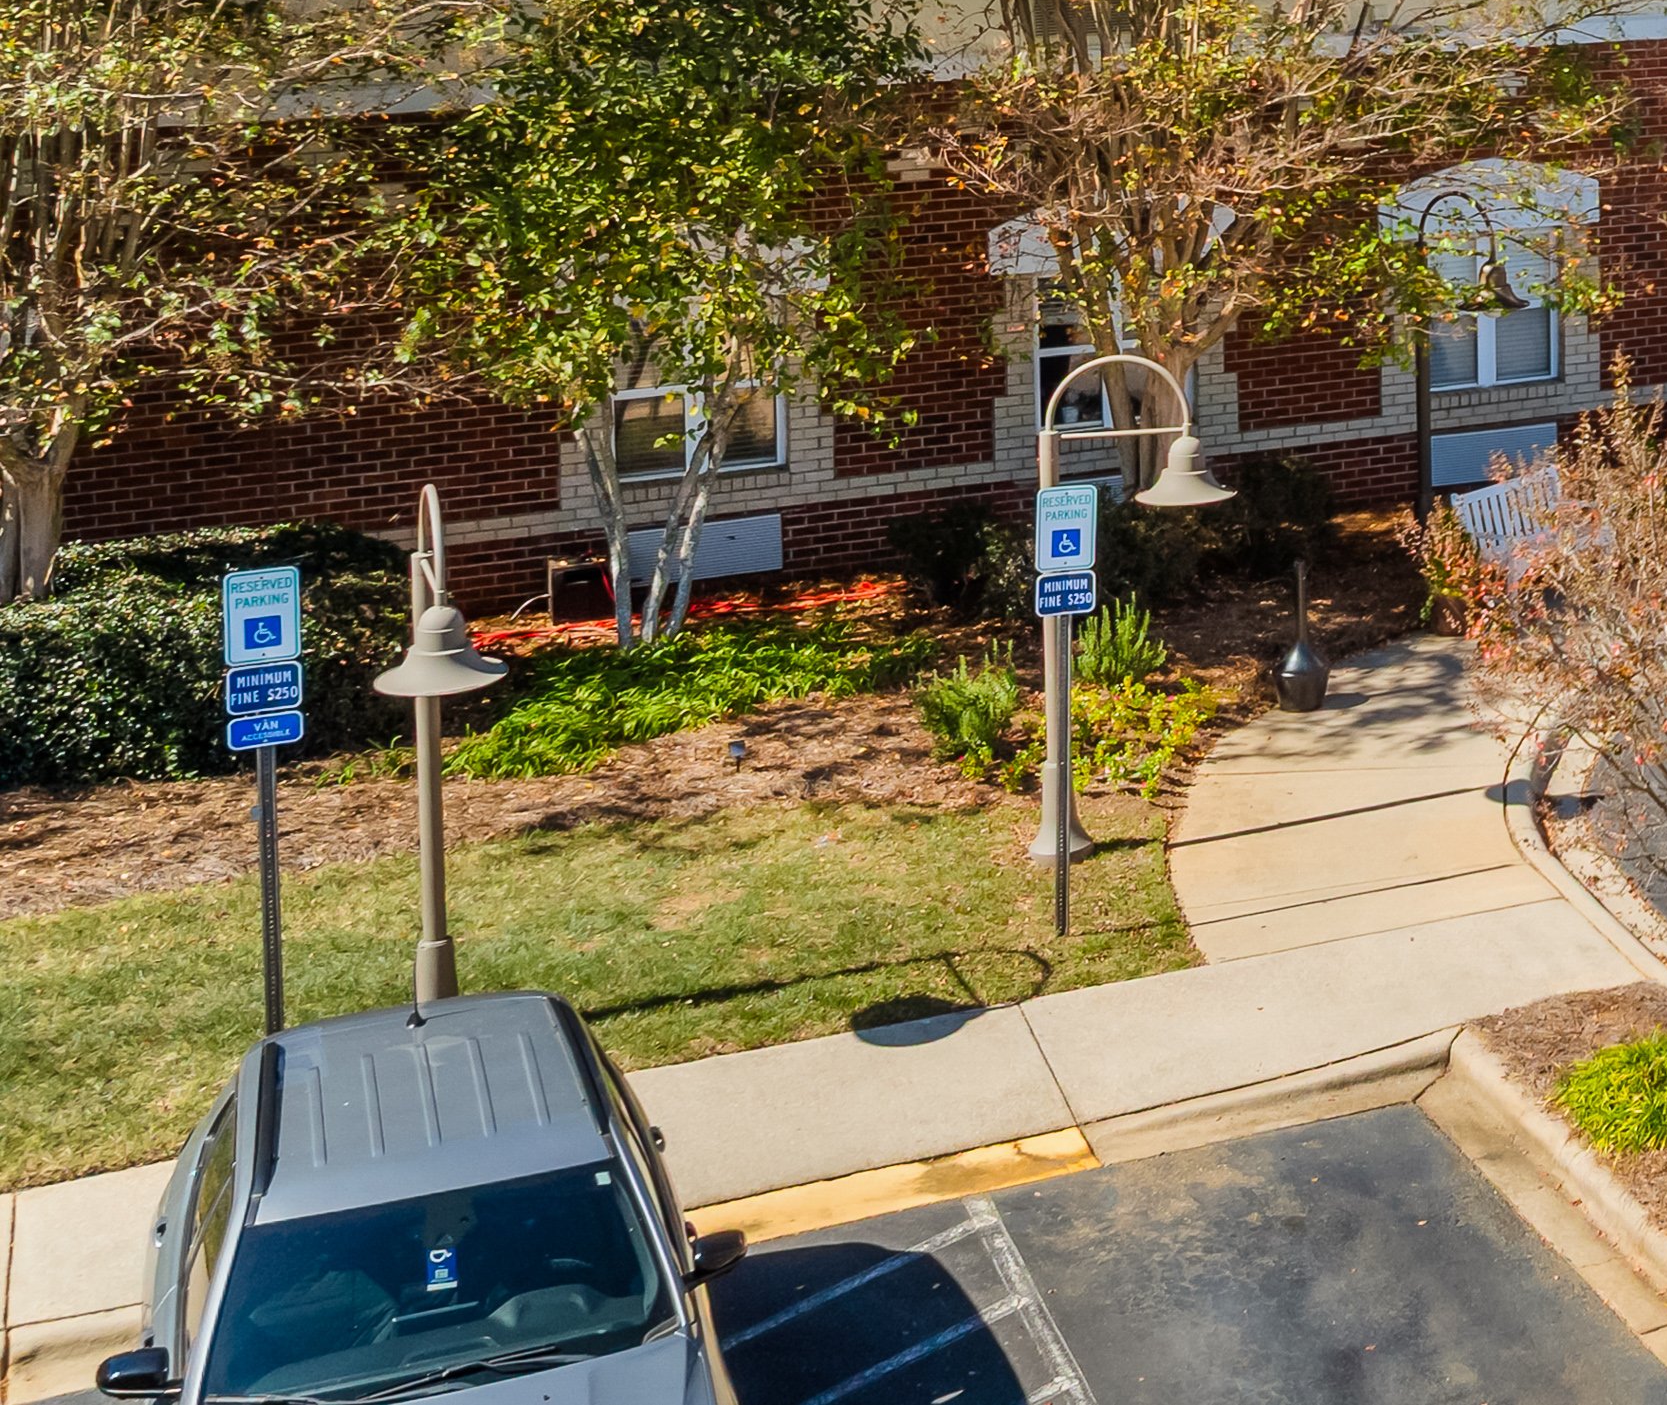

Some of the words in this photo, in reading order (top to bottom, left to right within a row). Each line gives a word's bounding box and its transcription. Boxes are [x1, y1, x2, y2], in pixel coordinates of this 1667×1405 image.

[1042, 494, 1091, 508] RESERVED
[1045, 508, 1088, 521] PARKING
[231, 576, 293, 594] RESERVED
[1044, 578, 1088, 594] MINIMUM
[235, 592, 289, 609] PARKING
[1040, 594, 1062, 609] FINE
[236, 670, 292, 689] MINIMUM
[230, 690, 260, 706] FINE
[253, 720, 279, 732] VAN
